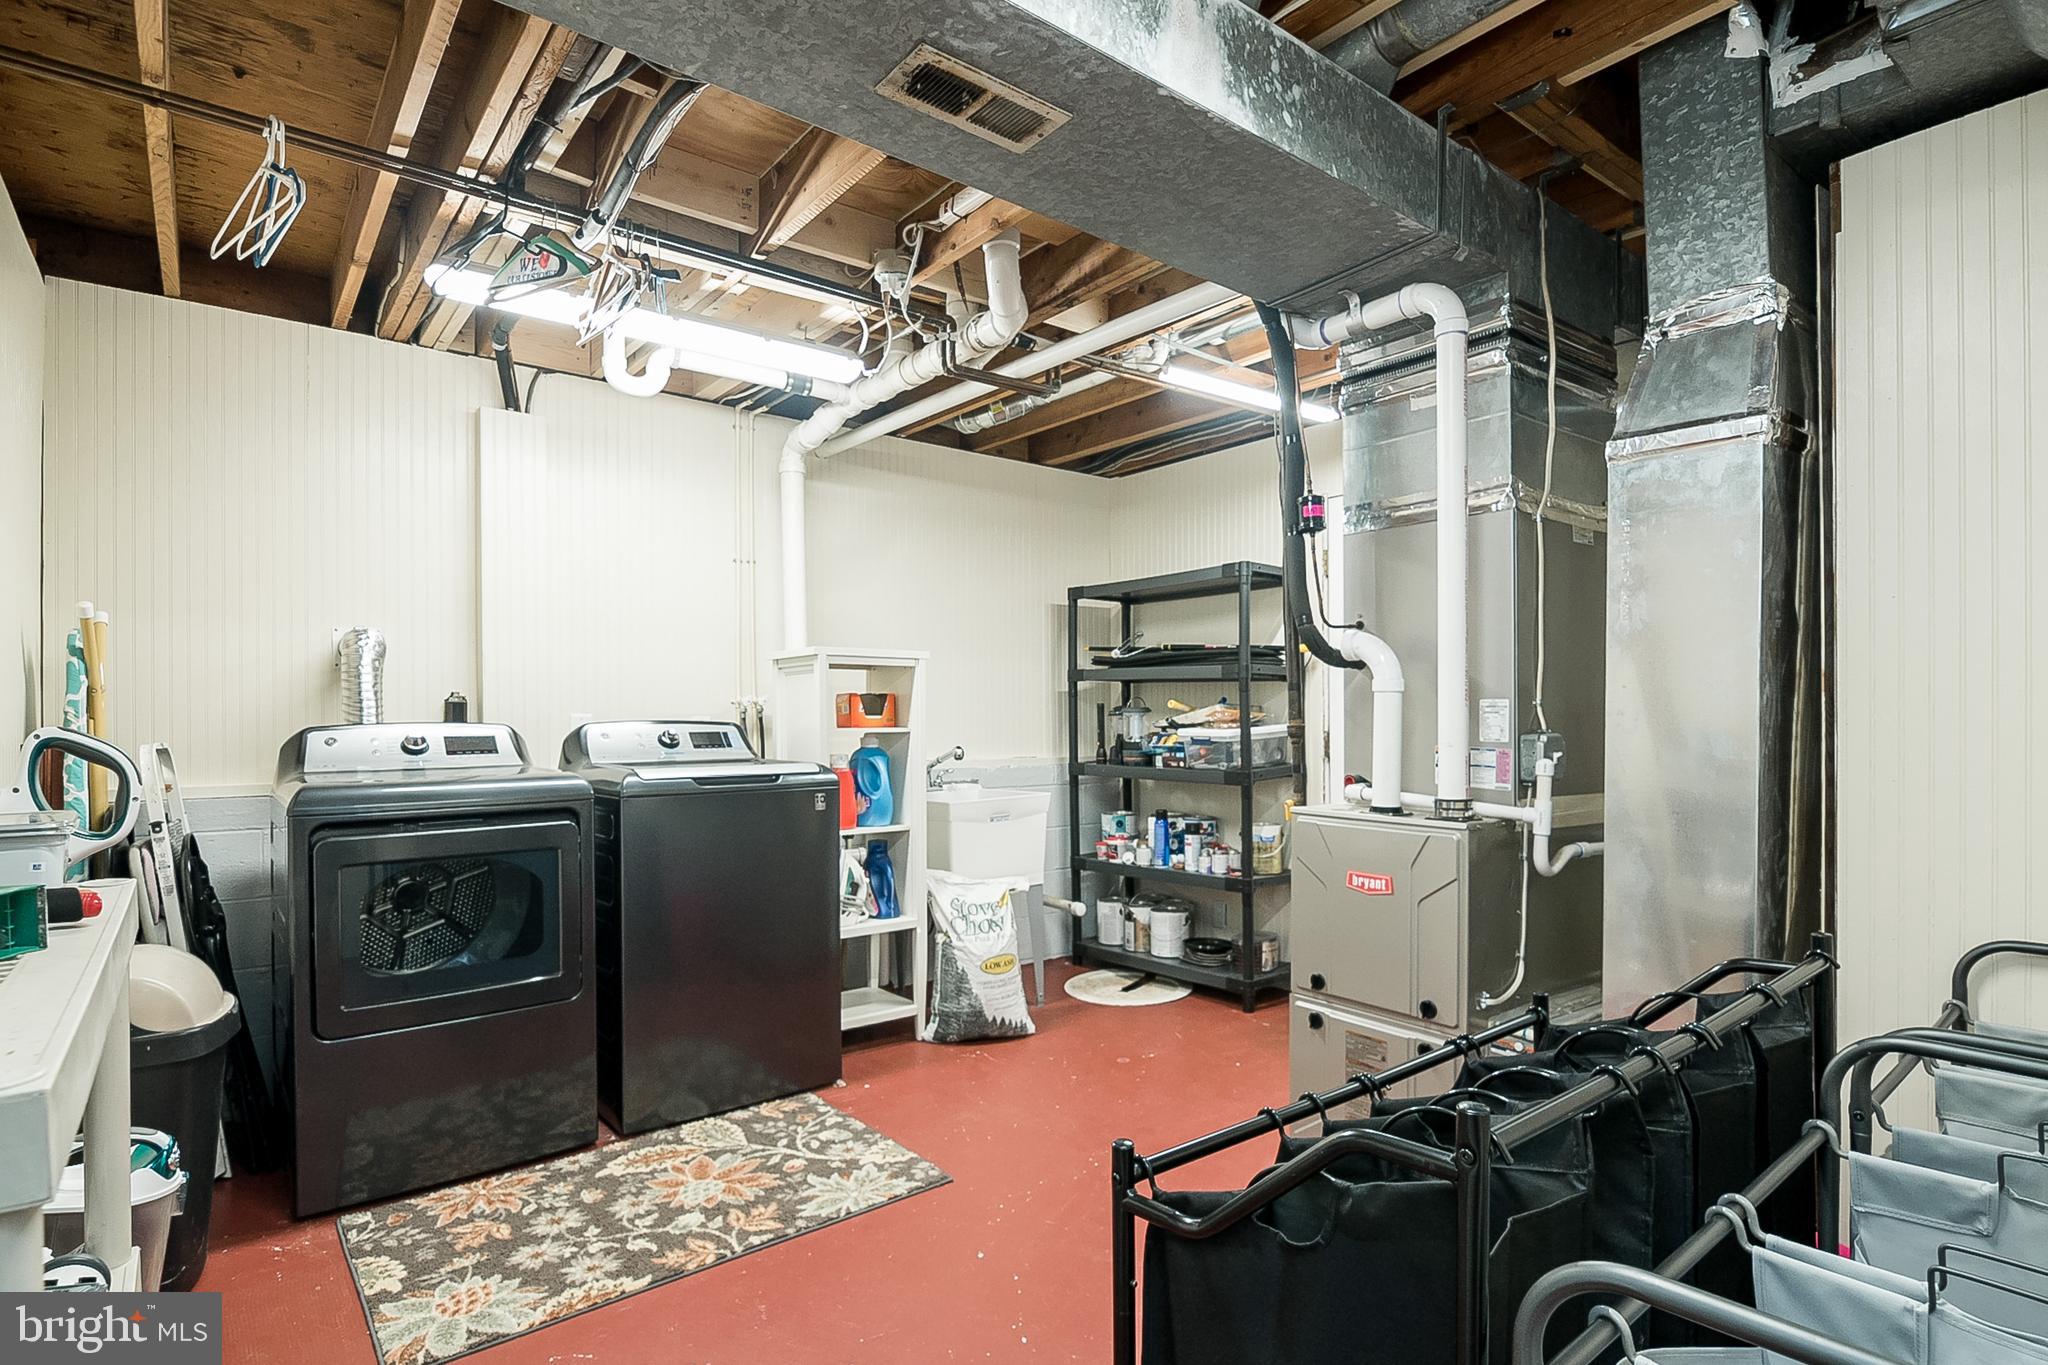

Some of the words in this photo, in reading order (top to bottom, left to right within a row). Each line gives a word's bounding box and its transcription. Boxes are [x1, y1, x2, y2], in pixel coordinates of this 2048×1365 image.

[520, 257, 539, 272] WE
[1352, 874, 1386, 890] bryant
[984, 961, 1001, 970] LOW
